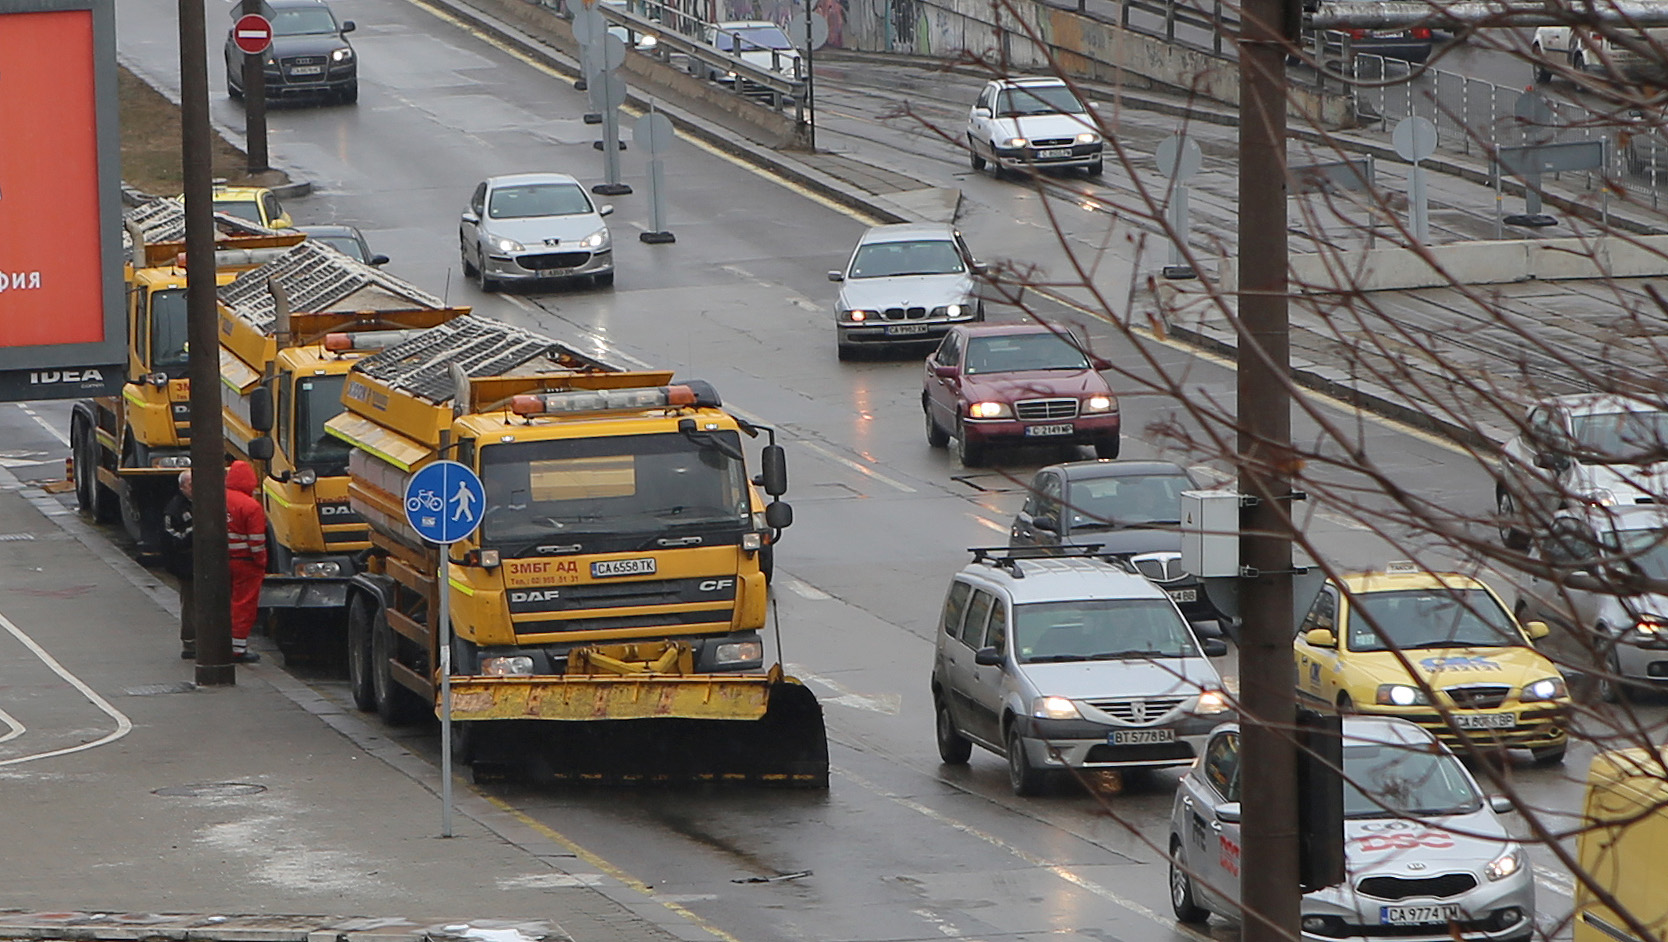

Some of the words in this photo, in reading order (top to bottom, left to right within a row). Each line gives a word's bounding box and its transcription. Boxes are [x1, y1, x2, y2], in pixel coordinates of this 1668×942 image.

[30, 370, 103, 384] IDEA
[322, 506, 356, 515] DA
[510, 562, 551, 574] ЗМБГ
[556, 561, 578, 573] АД
[598, 563, 611, 574] CA
[613, 561, 639, 573] 6558
[640, 560, 654, 571] TK
[699, 579, 734, 591] CF
[511, 590, 559, 602] DAF
[1115, 732, 1130, 743] BT
[1158, 730, 1173, 742] BA
[1389, 908, 1406, 922] CA
[1408, 907, 1439, 921] 9774
